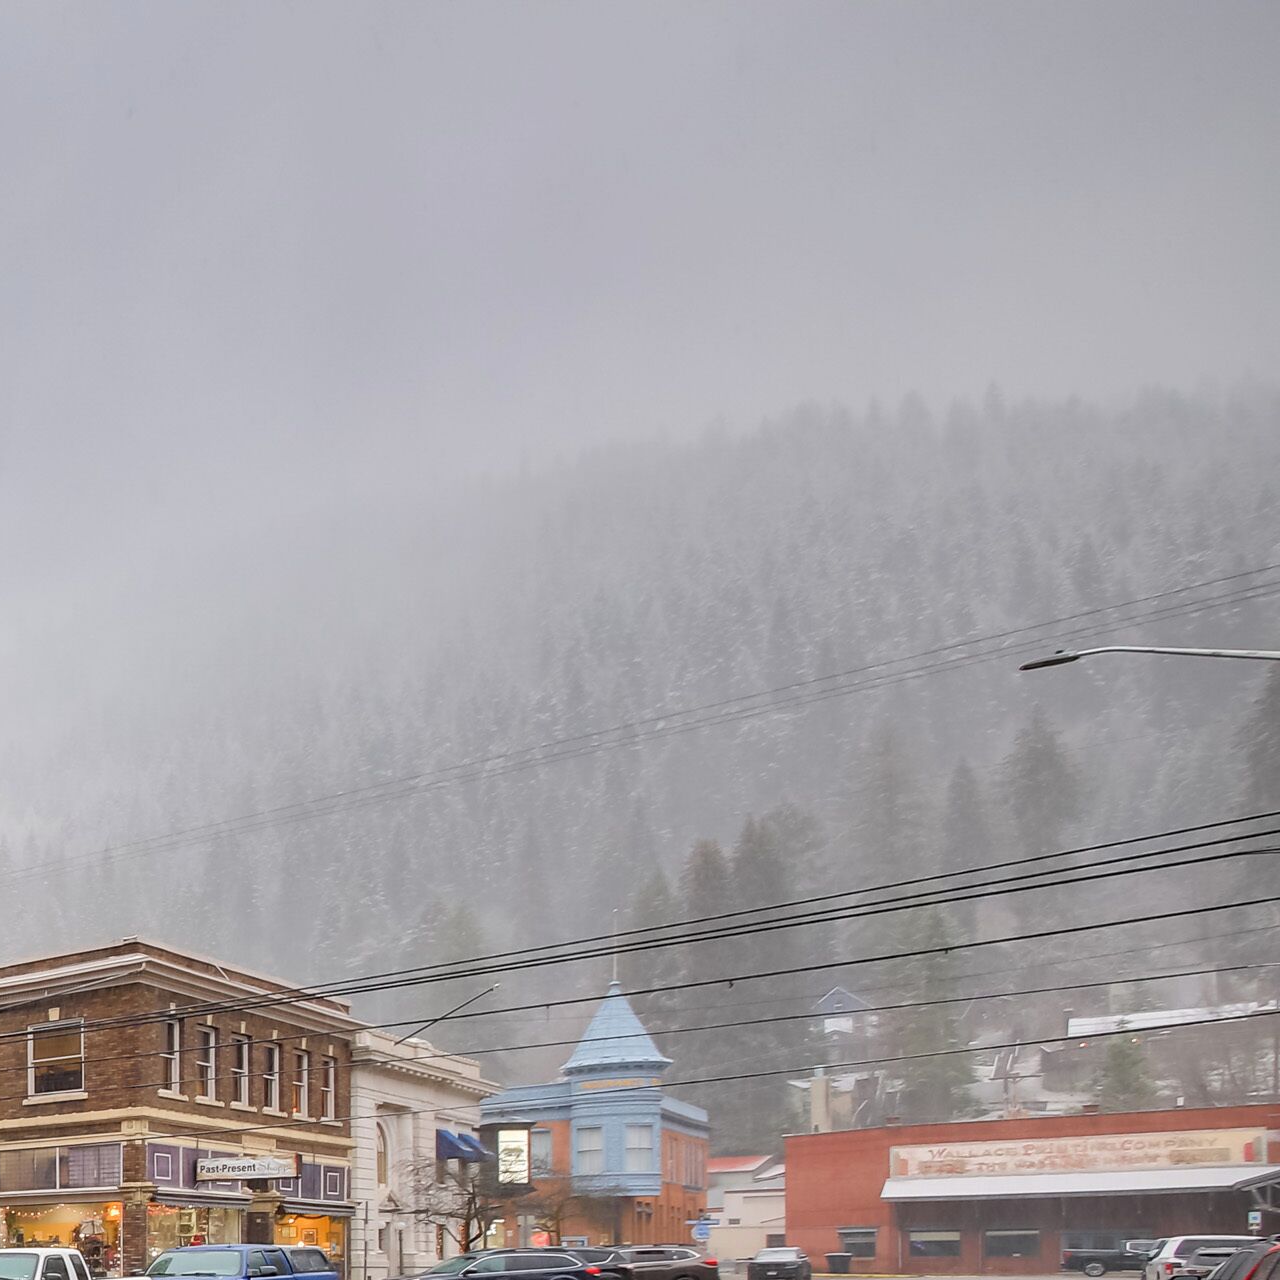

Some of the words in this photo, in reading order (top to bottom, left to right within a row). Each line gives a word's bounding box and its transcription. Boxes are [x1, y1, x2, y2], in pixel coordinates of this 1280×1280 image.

[927, 1147, 1018, 1160] WALLACE
[1120, 1136, 1219, 1151] COMPANY
[200, 1163, 256, 1174] Past-Present
